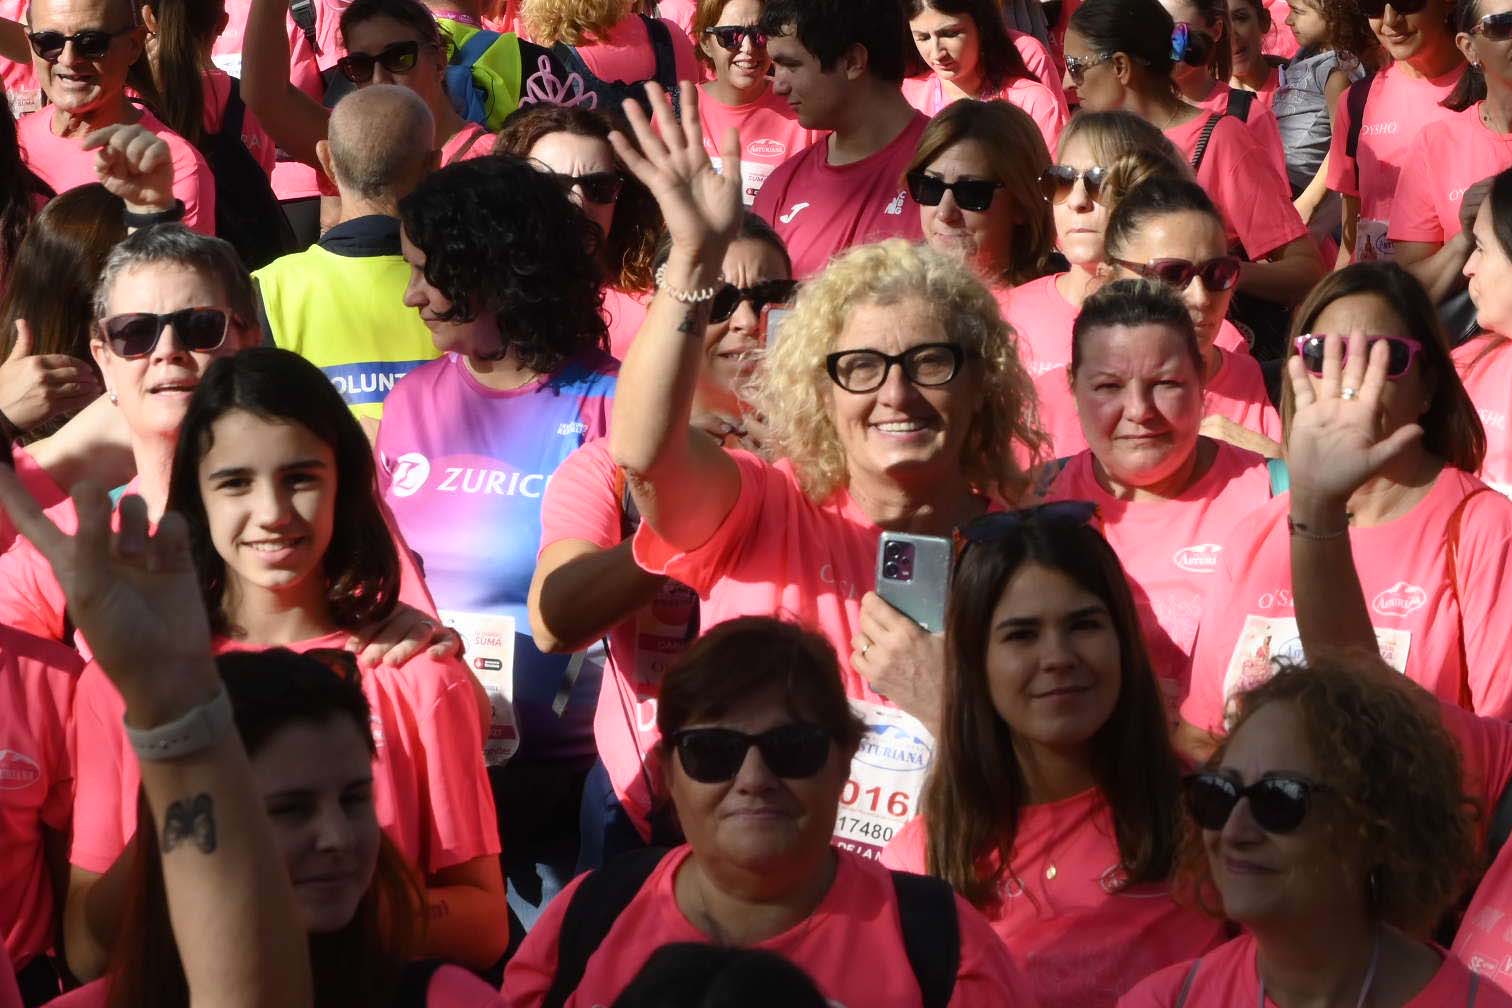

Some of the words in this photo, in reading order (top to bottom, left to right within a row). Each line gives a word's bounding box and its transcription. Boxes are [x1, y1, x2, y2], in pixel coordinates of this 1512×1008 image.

[437, 467, 551, 498] ZURIC
[859, 740, 924, 766] STURIANA
[839, 779, 911, 818] 016
[838, 815, 894, 843] 17480
